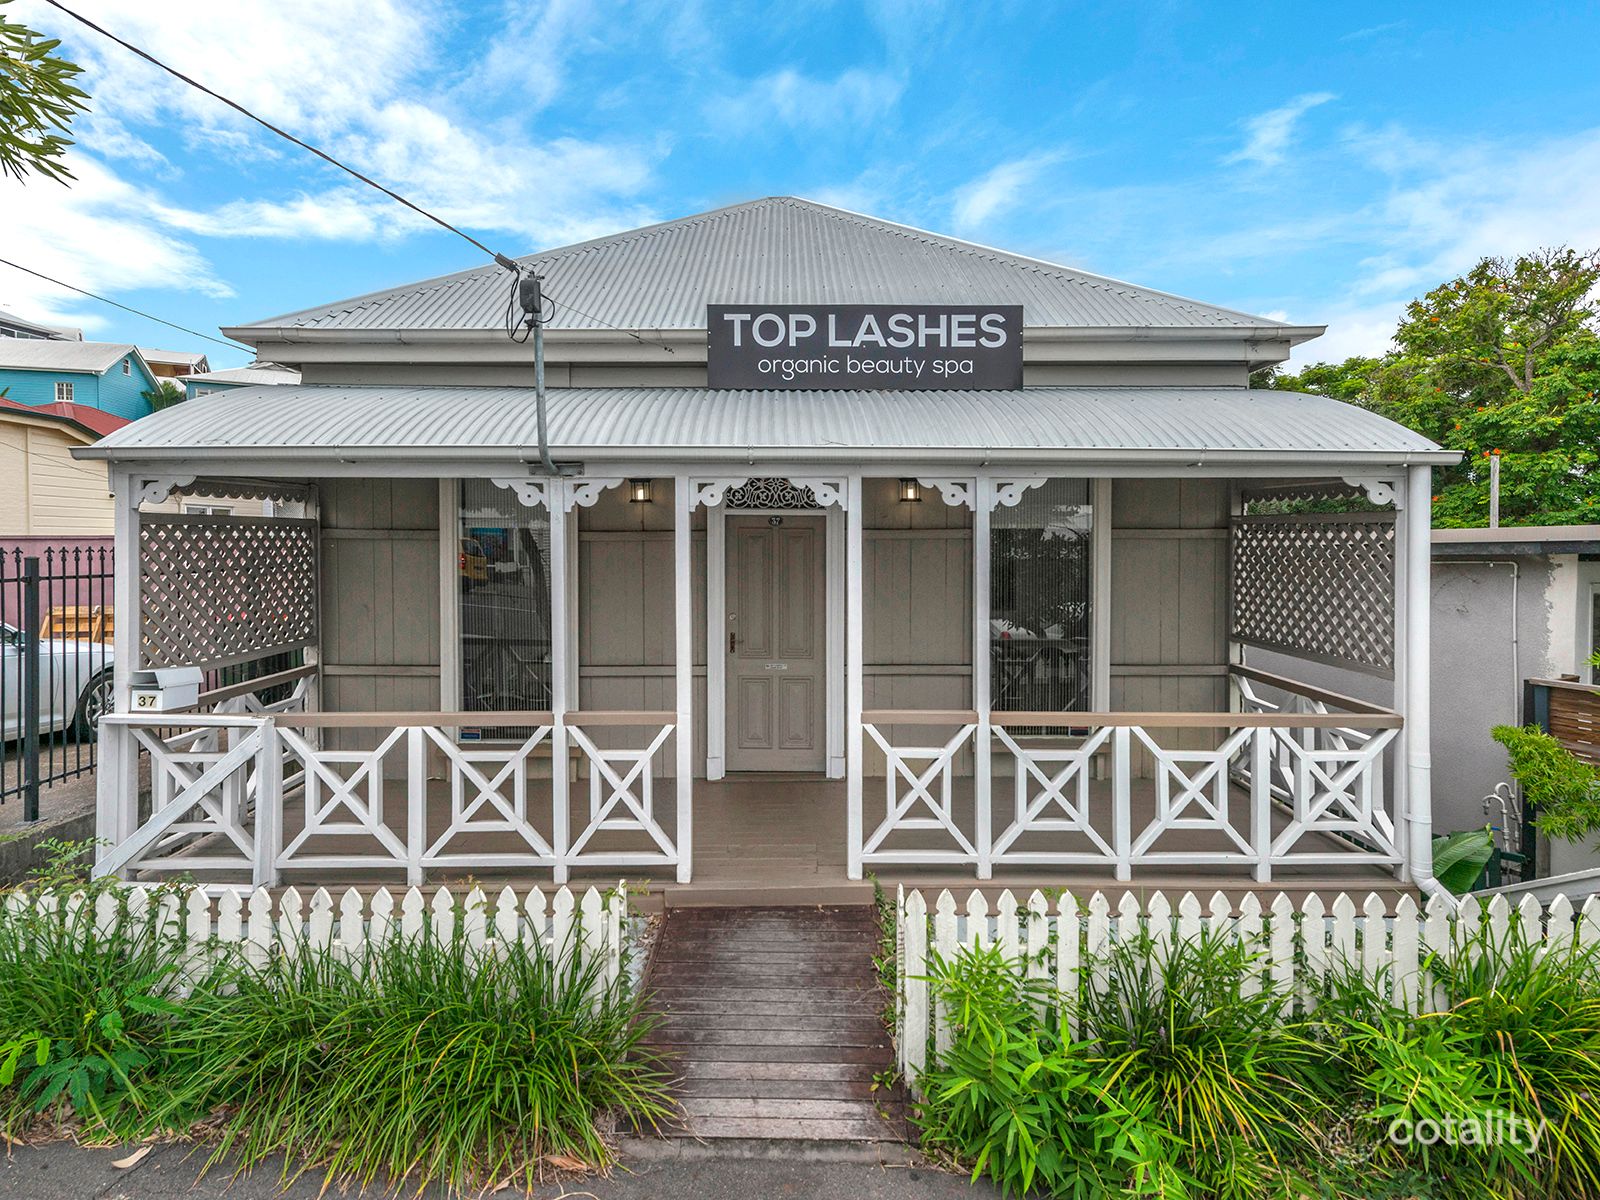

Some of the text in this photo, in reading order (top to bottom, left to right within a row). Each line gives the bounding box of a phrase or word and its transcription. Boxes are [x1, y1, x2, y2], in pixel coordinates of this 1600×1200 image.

[723, 313, 1007, 348] TOP LASHES
[757, 355, 974, 380] organic beauty spa
[771, 517, 781, 525] 37
[138, 696, 156, 707] 37
